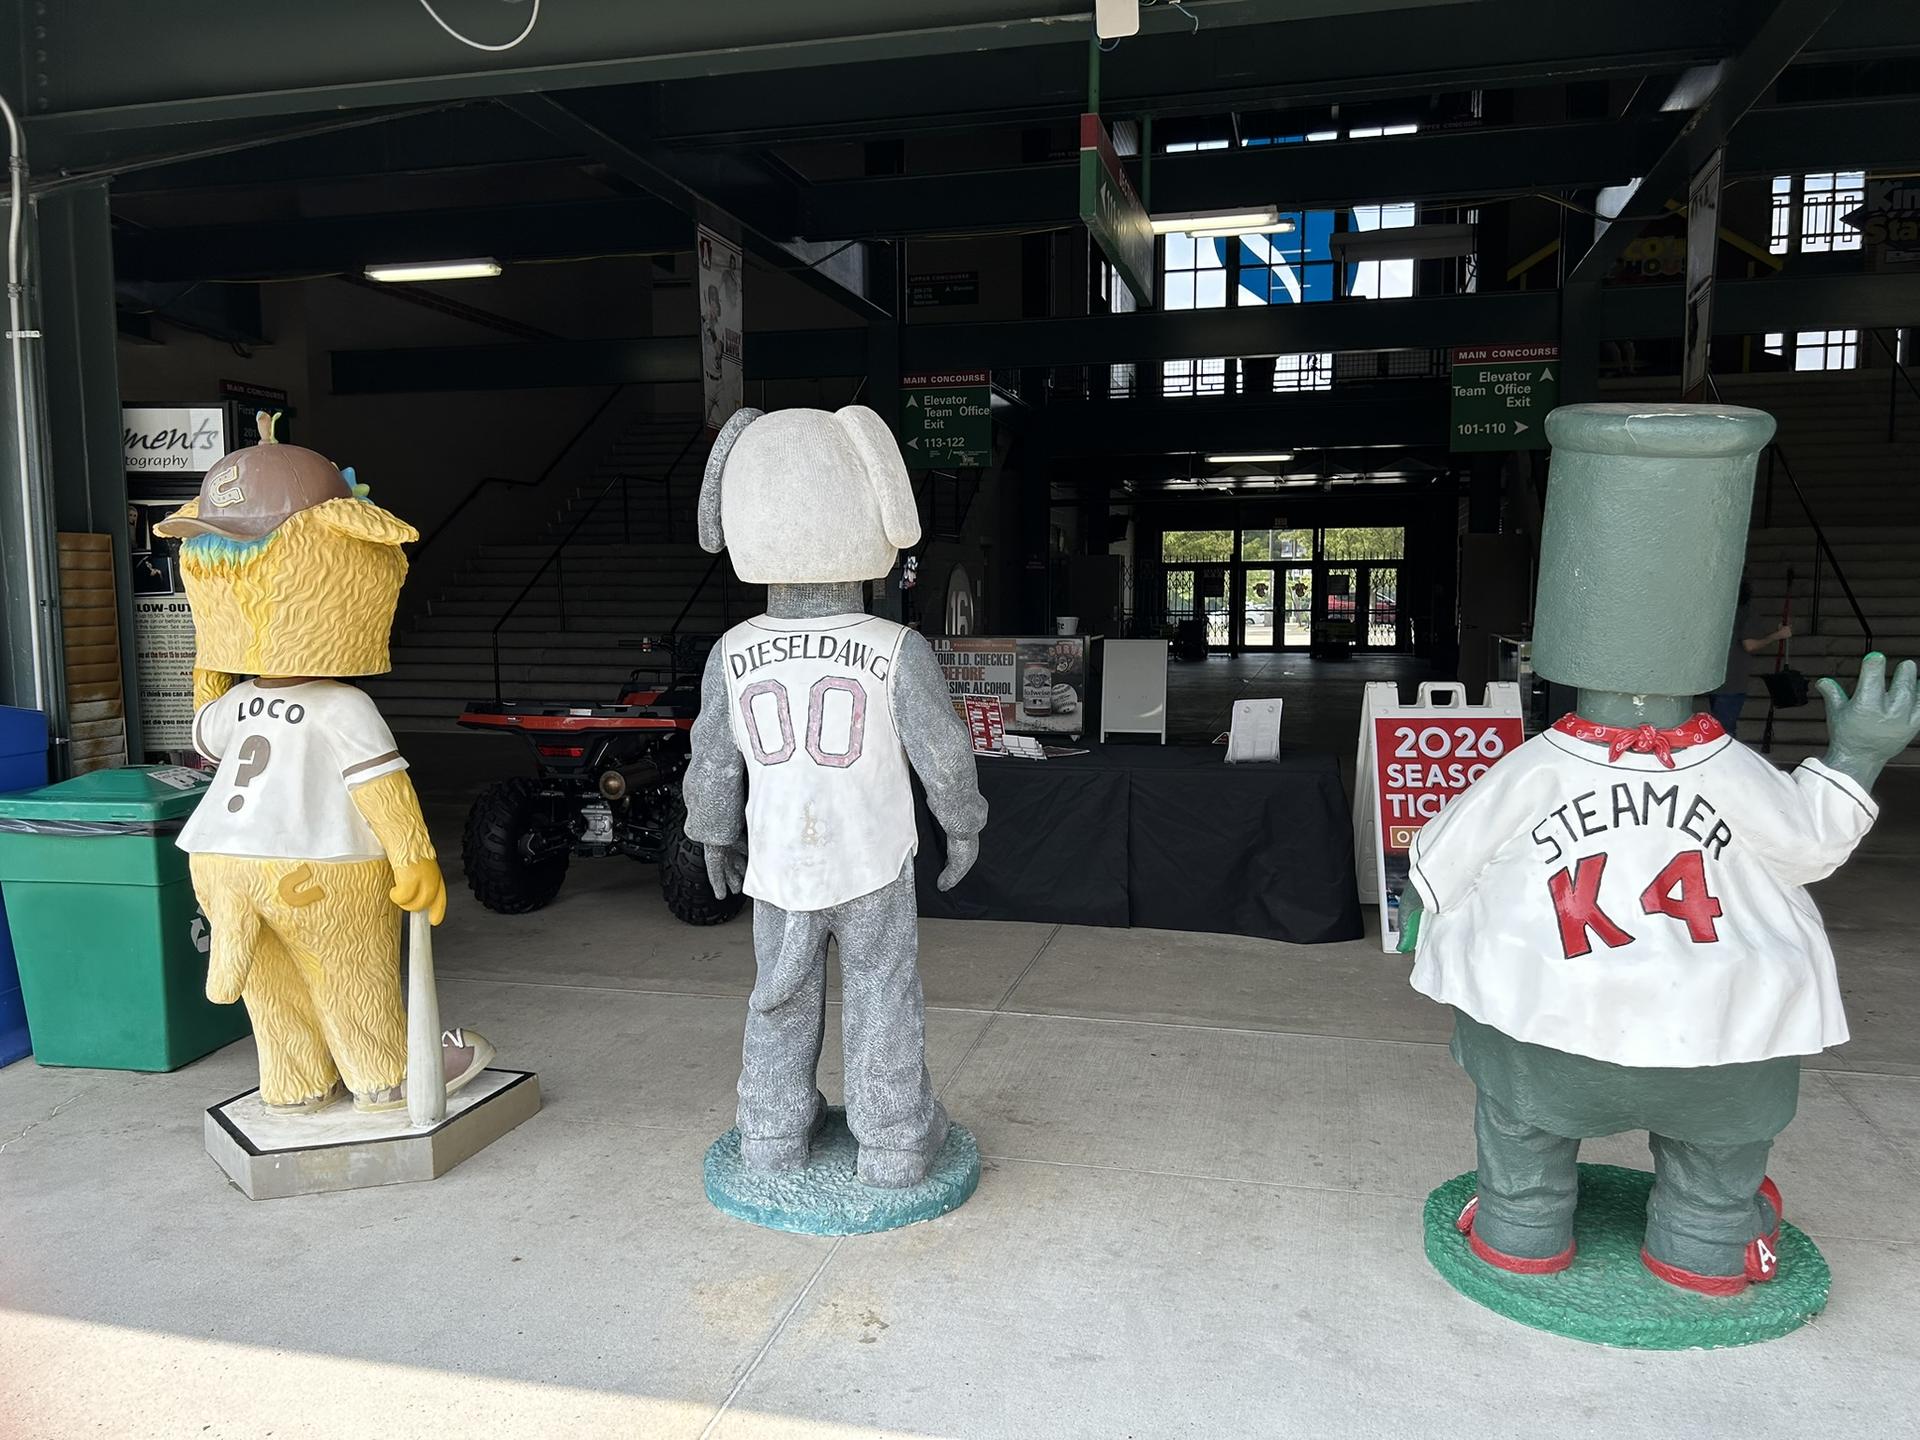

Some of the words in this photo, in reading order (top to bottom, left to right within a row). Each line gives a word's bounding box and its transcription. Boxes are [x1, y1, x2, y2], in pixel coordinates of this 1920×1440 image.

[1458, 351, 1487, 360] MAIN
[1492, 347, 1559, 358] CONCOURSE
[903, 376, 927, 385] MAIN
[931, 374, 986, 383] CONCOURSE
[1479, 371, 1532, 382] Elevator
[1453, 386, 1486, 397] Team
[1494, 384, 1531, 395] Office
[924, 395, 967, 406] Elevator
[1506, 396, 1531, 407] Exit
[924, 407, 953, 417] Team
[959, 406, 990, 416] Office
[924, 419, 945, 429] Exit
[1457, 423, 1506, 435] 101-110
[924, 437, 965, 448] 113-122
[729, 634, 889, 682] DIESELDAWG
[935, 653, 956, 665] OUR
[958, 653, 972, 666] I.D.
[974, 653, 1014, 666] CHECKED
[946, 681, 970, 694] SING
[973, 681, 1013, 695] ALCOHOL
[238, 697, 305, 724] LOCO
[739, 675, 868, 768] 00
[1394, 726, 1505, 759] 2026
[1531, 781, 1733, 865] STEAMER
[1757, 1239, 1776, 1273] A
